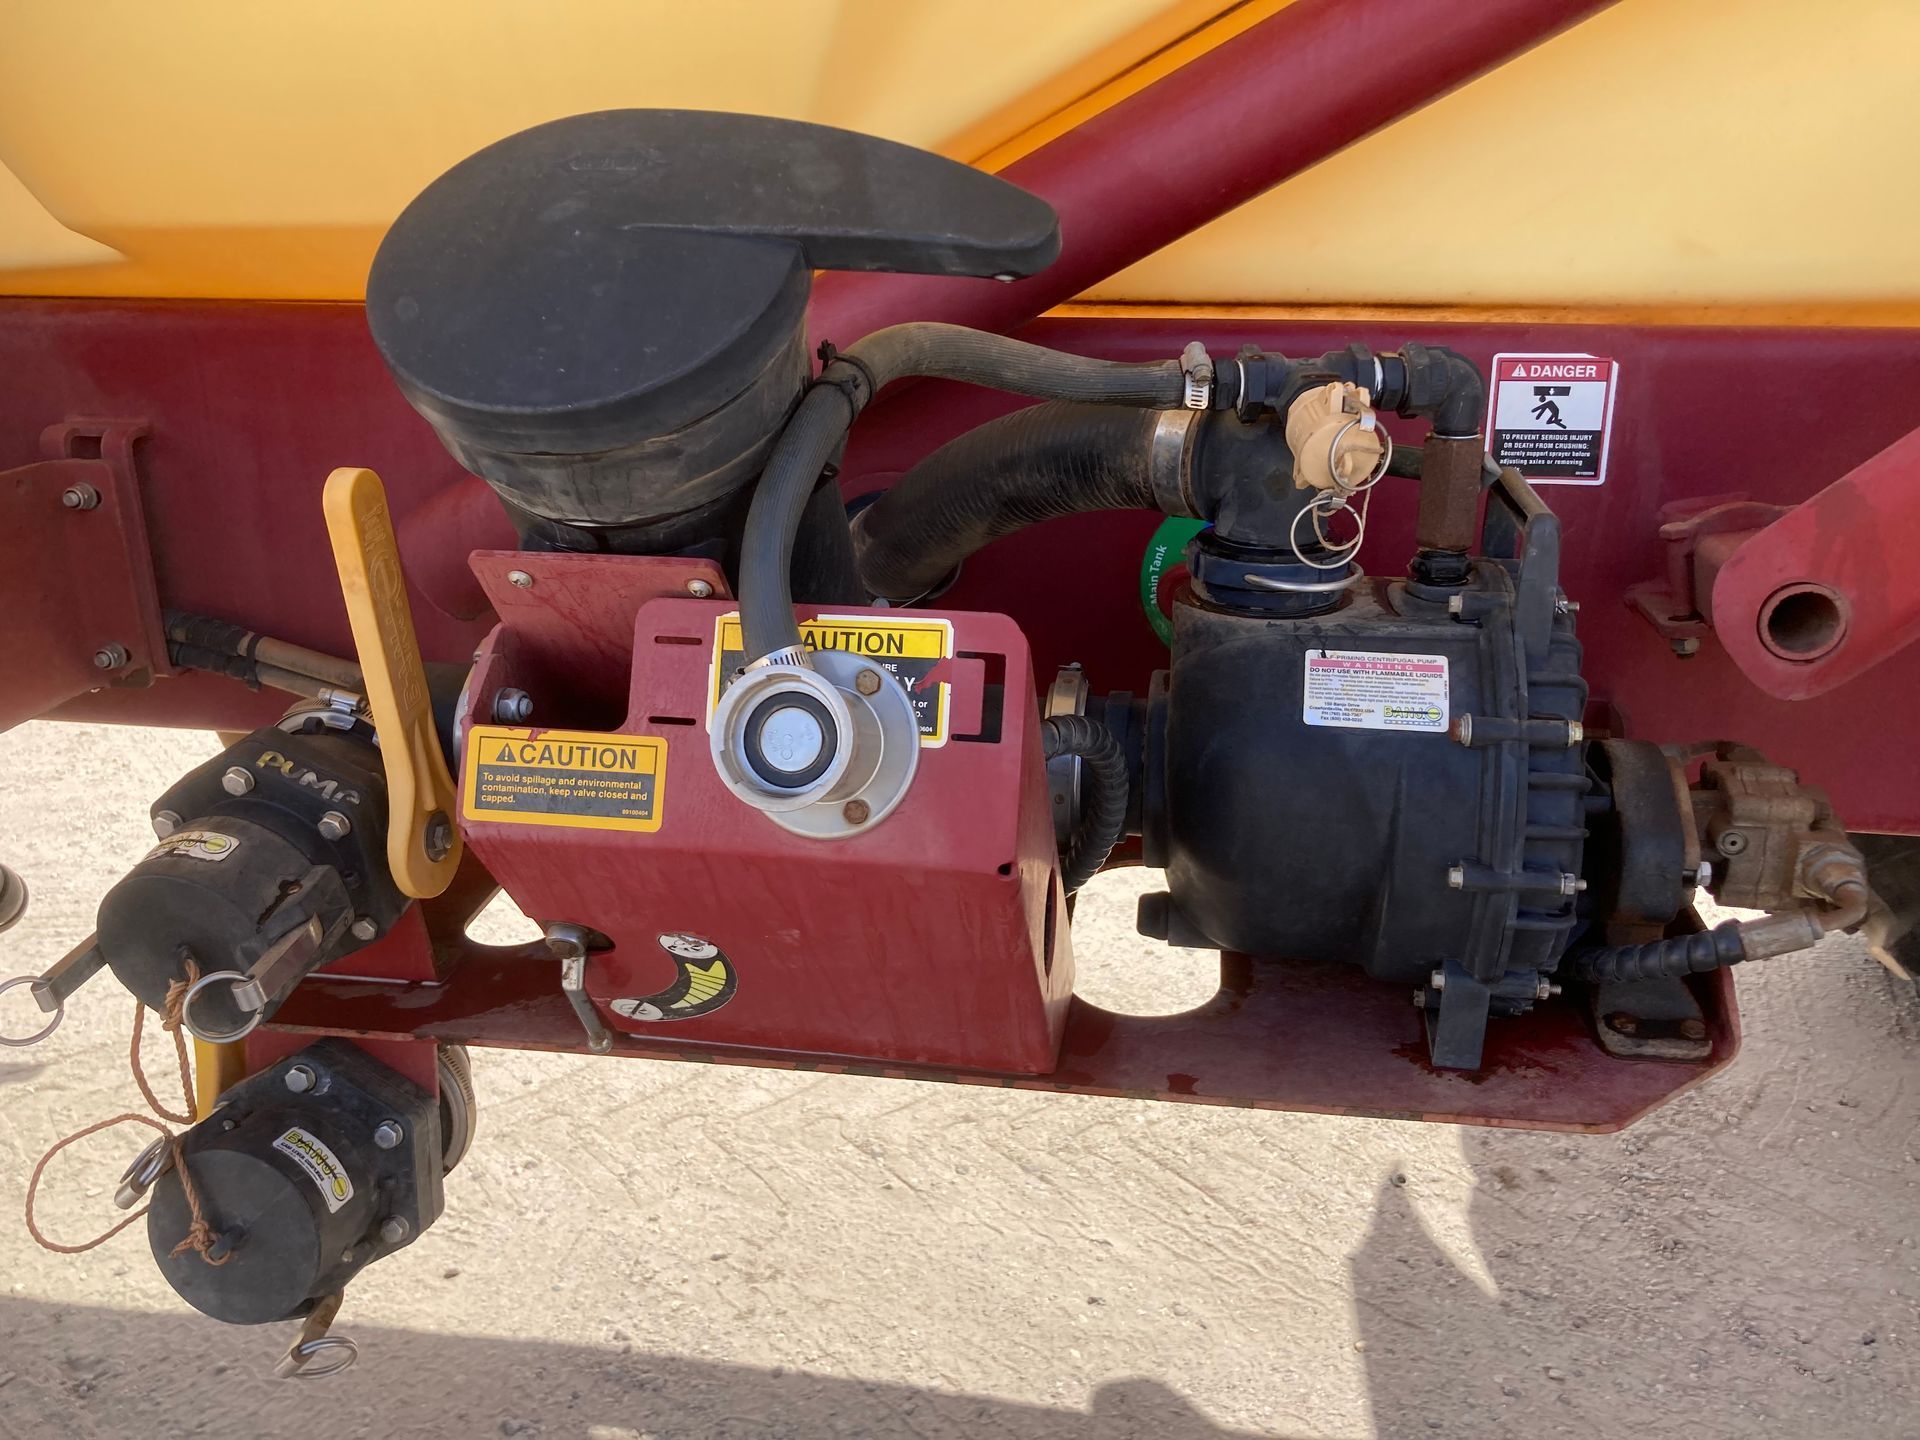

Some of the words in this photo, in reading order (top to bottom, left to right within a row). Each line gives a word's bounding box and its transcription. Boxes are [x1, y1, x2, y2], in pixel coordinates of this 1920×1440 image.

[1530, 365, 1597, 378] DANGER
[1150, 544, 1168, 572] Tank
[1149, 575, 1159, 604] Main
[802, 630, 904, 654] AUTION
[1342, 662, 1413, 670] WARNING
[1367, 656, 1415, 664] CENTRIFUGAL
[520, 744, 637, 770] CAUTION
[483, 772, 494, 781] To
[496, 773, 519, 782] avoid
[522, 774, 556, 786] spillage
[558, 777, 576, 786] and
[577, 777, 642, 790] environmental
[482, 784, 547, 795] contamination,
[550, 786, 570, 798] keep
[573, 788, 596, 798] valve
[598, 790, 628, 800] closed
[630, 792, 648, 801] and
[482, 793, 516, 804] capped.
